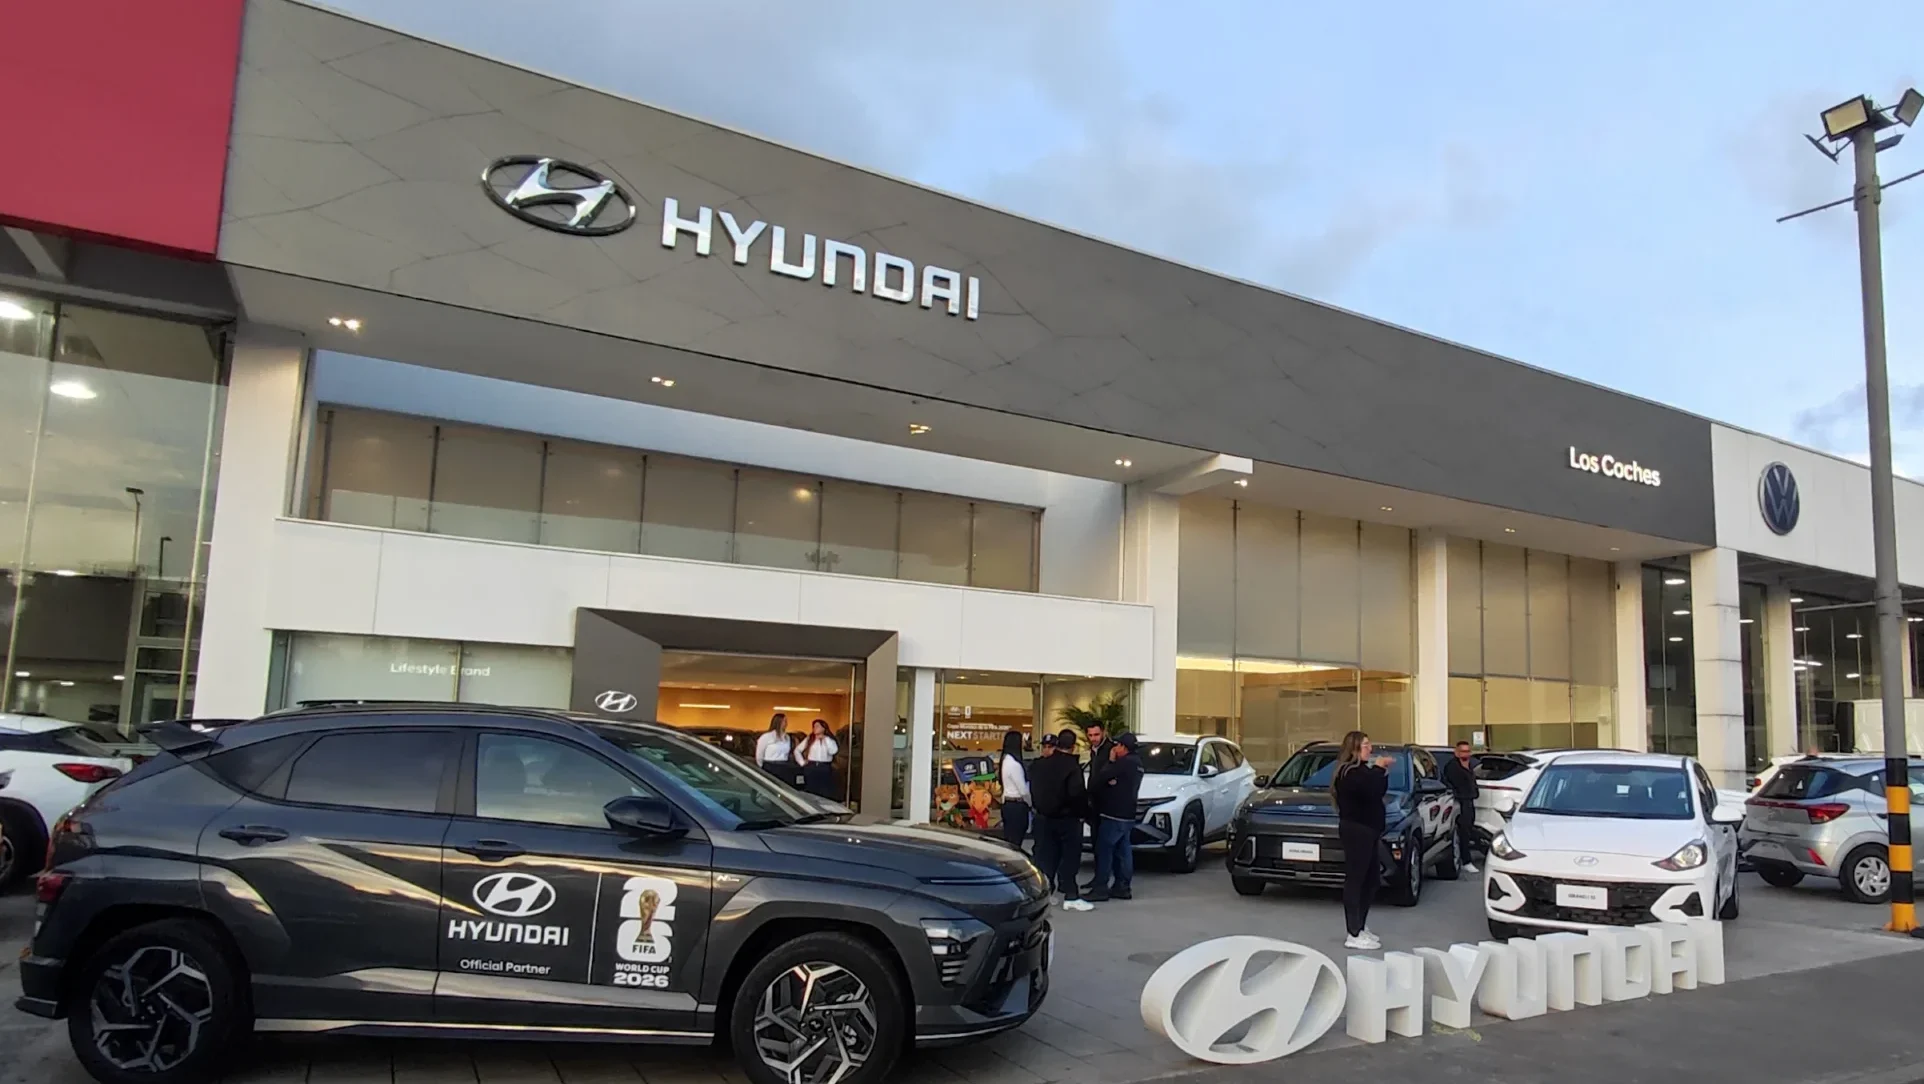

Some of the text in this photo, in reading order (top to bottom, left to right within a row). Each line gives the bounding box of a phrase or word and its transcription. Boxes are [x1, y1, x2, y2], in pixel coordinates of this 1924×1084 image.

[661, 197, 980, 320] HYUNDAI
[1569, 445, 1661, 487] Los Coches
[390, 663, 448, 676] Lifestyle
[946, 731, 972, 740] NEXT
[448, 919, 569, 946] HYUNDAI
[632, 944, 656, 954] FIFA
[460, 959, 551, 975] Official Partner
[615, 962, 670, 974] WORLD CUP
[613, 972, 669, 988] 2026
[1346, 918, 1725, 1044] HYUNDAI
